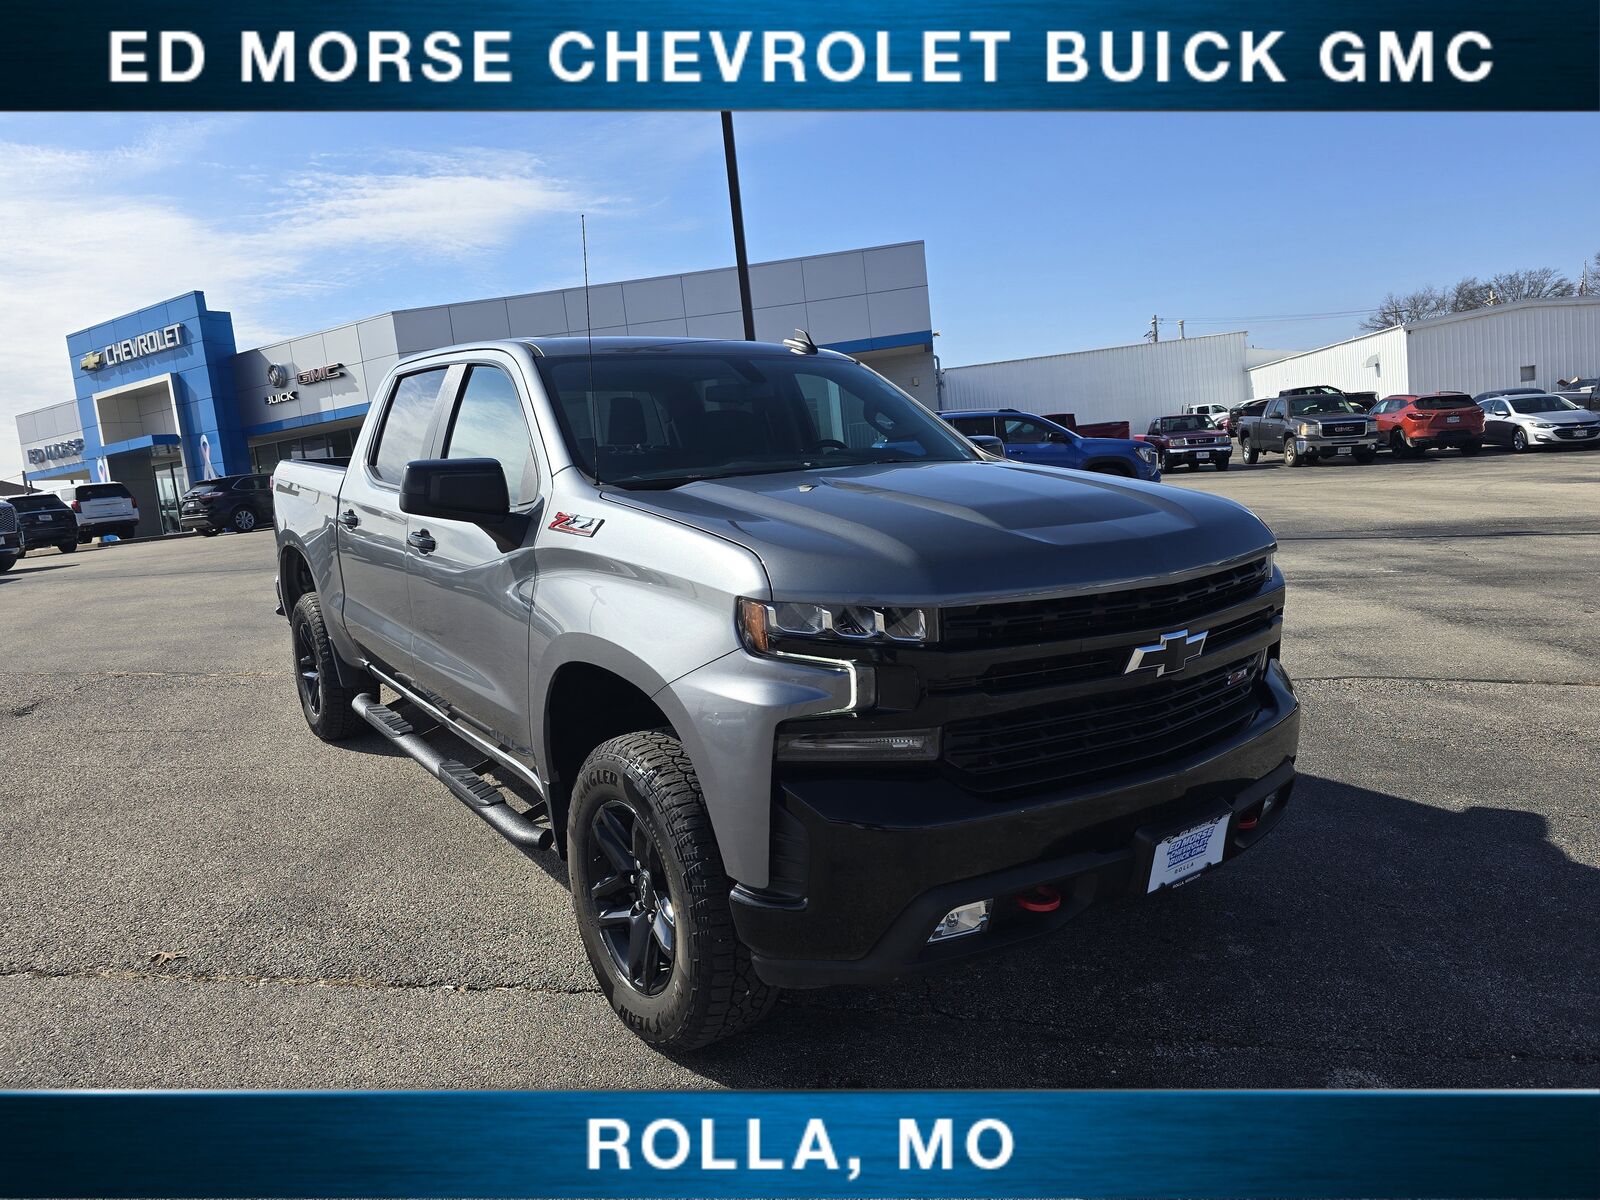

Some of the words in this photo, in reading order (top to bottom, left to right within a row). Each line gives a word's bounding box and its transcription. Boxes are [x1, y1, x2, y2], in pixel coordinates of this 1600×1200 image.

[105, 322, 184, 366] CHEVROLET
[296, 362, 345, 385] GMC
[266, 391, 296, 406] BUICK
[548, 511, 605, 538] Z71
[1170, 840, 1182, 852] ED
[1181, 826, 1215, 846] MORSE
[1170, 837, 1208, 859] CHEVROLET
[1174, 862, 1194, 874] ROLLA
